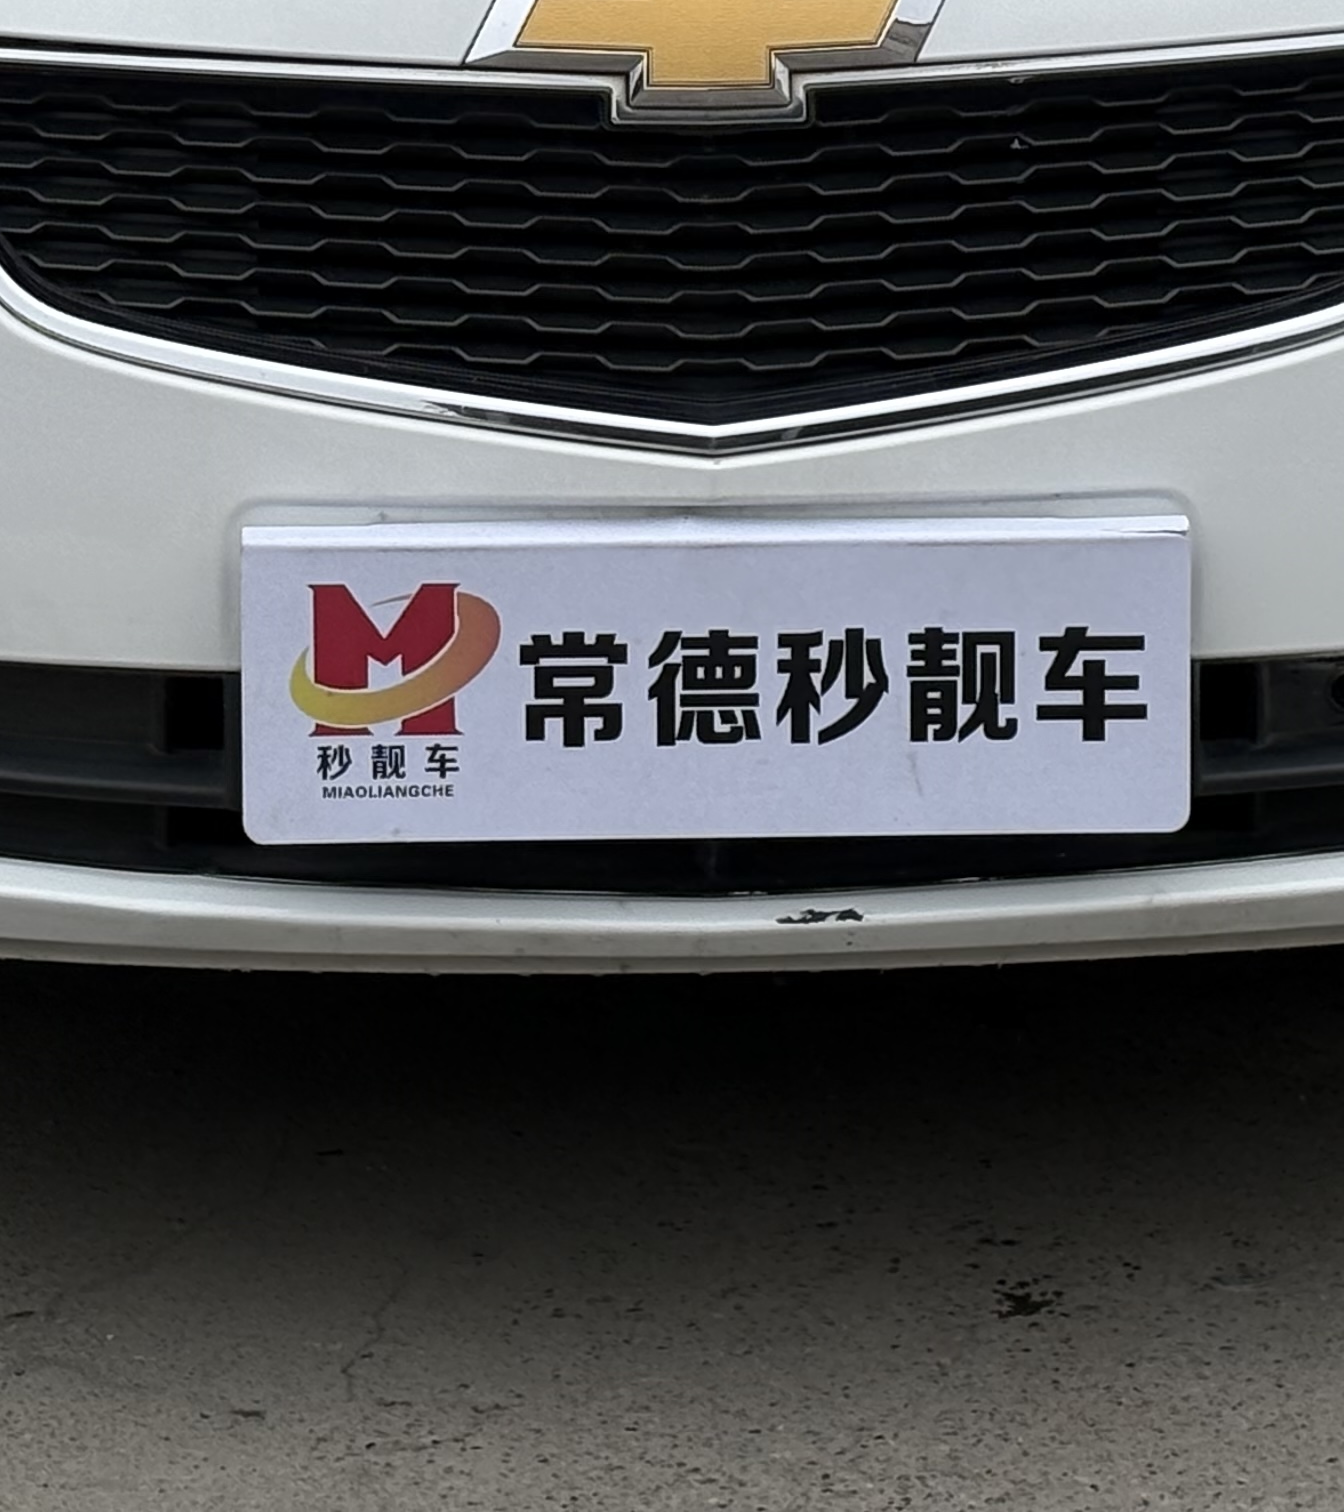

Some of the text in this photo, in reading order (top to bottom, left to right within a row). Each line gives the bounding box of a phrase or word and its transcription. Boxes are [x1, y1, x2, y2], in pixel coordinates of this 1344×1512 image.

[518, 626, 1148, 748] 常德秒靓车
[316, 743, 460, 781] 秒靓车
[321, 785, 455, 799] MIAOLIANGCHE
